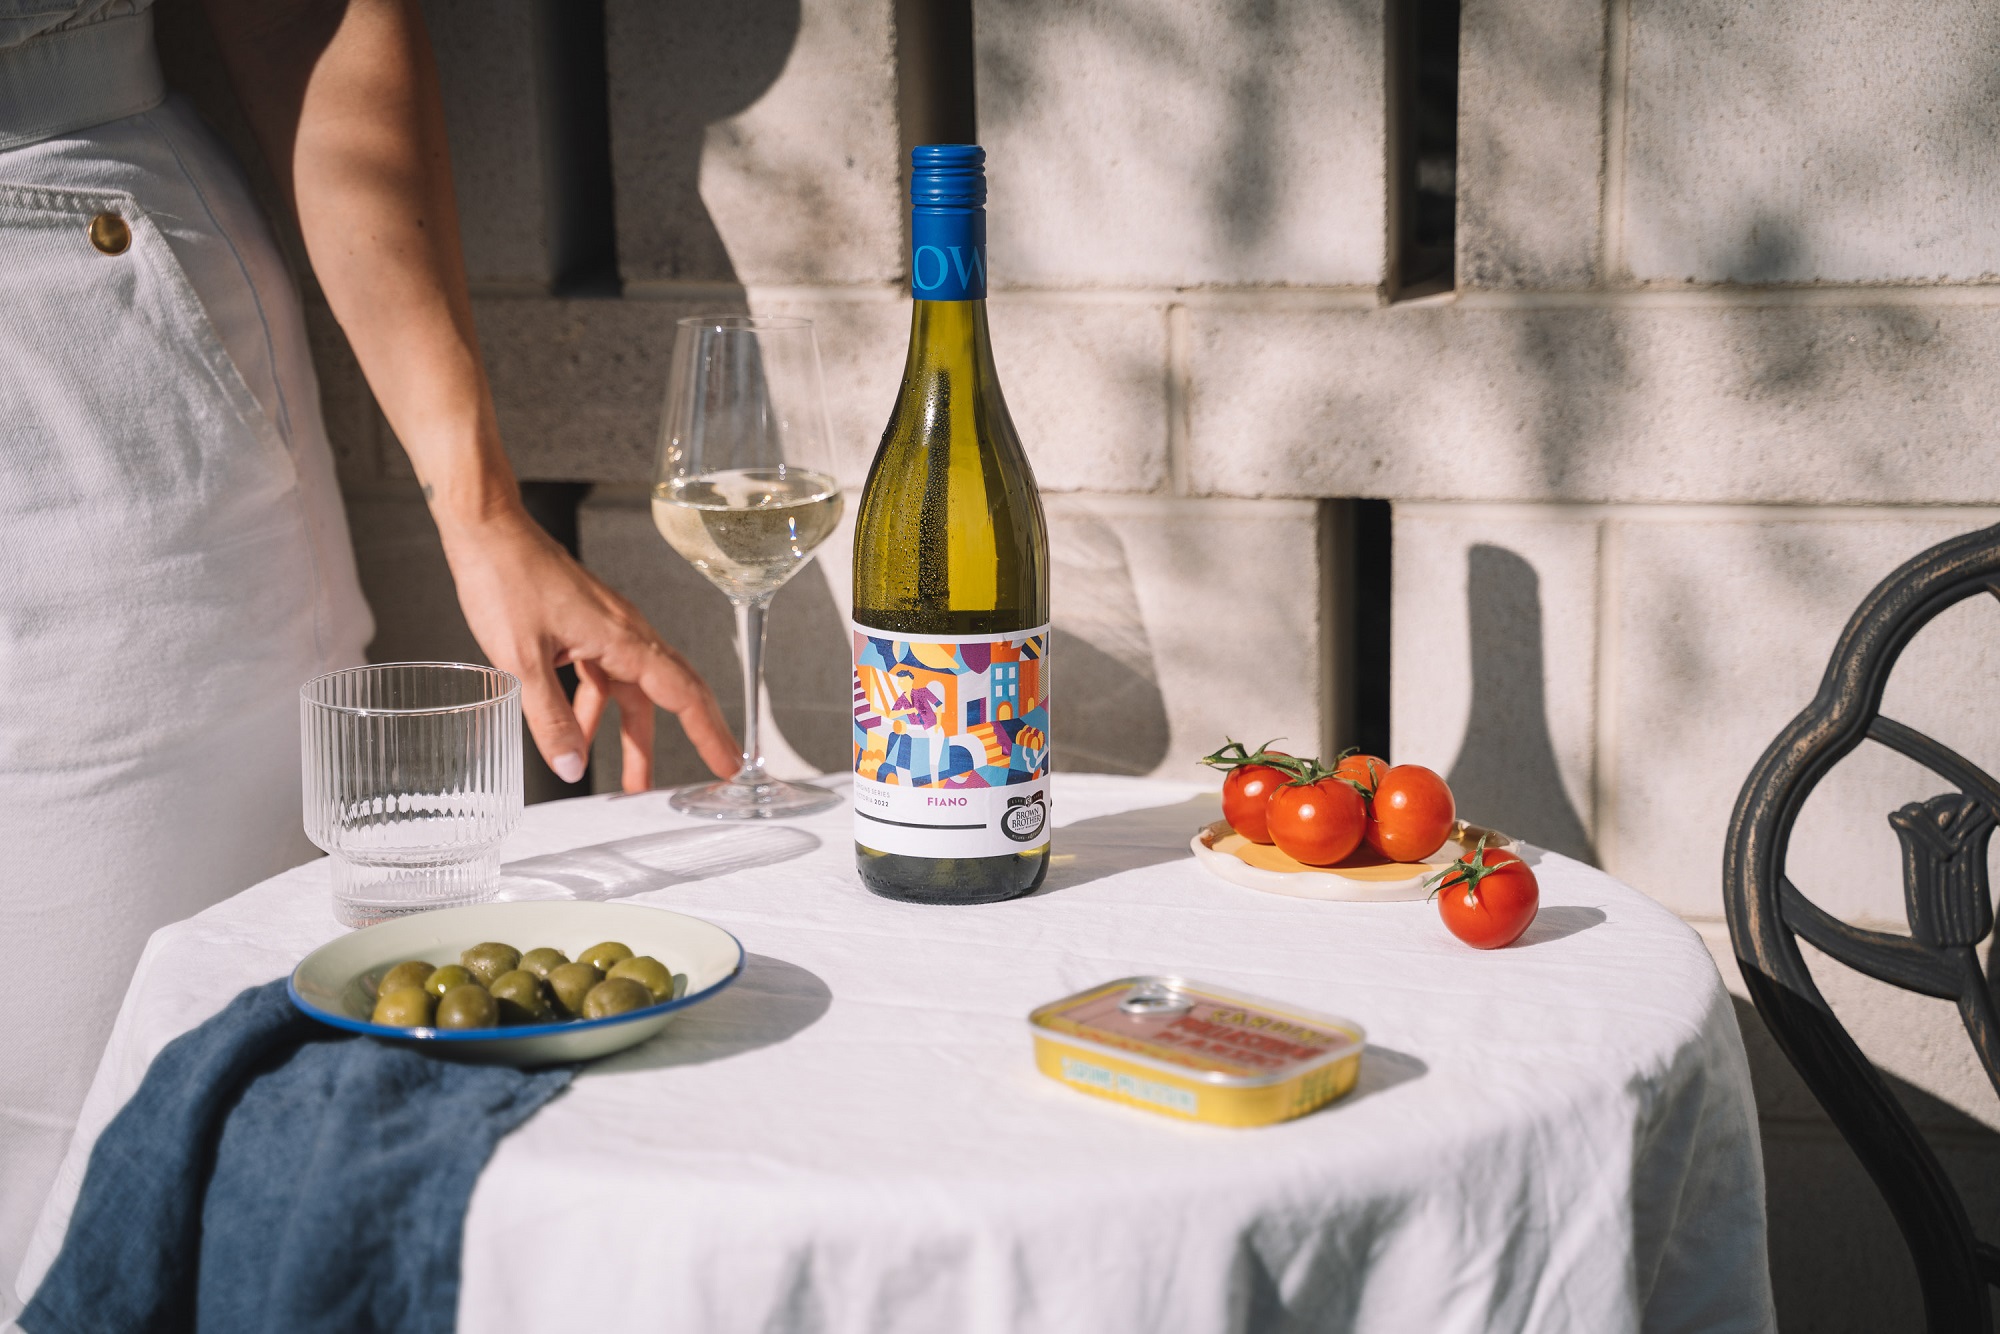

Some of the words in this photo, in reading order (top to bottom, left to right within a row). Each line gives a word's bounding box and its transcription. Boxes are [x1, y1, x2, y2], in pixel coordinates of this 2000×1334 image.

[912, 244, 987, 290] OW
[855, 790, 873, 803] ICTORIA
[874, 798, 889, 807] 2022
[871, 788, 890, 798] SERIES
[927, 797, 968, 807] FIANO
[1016, 807, 1039, 820] BROWN
